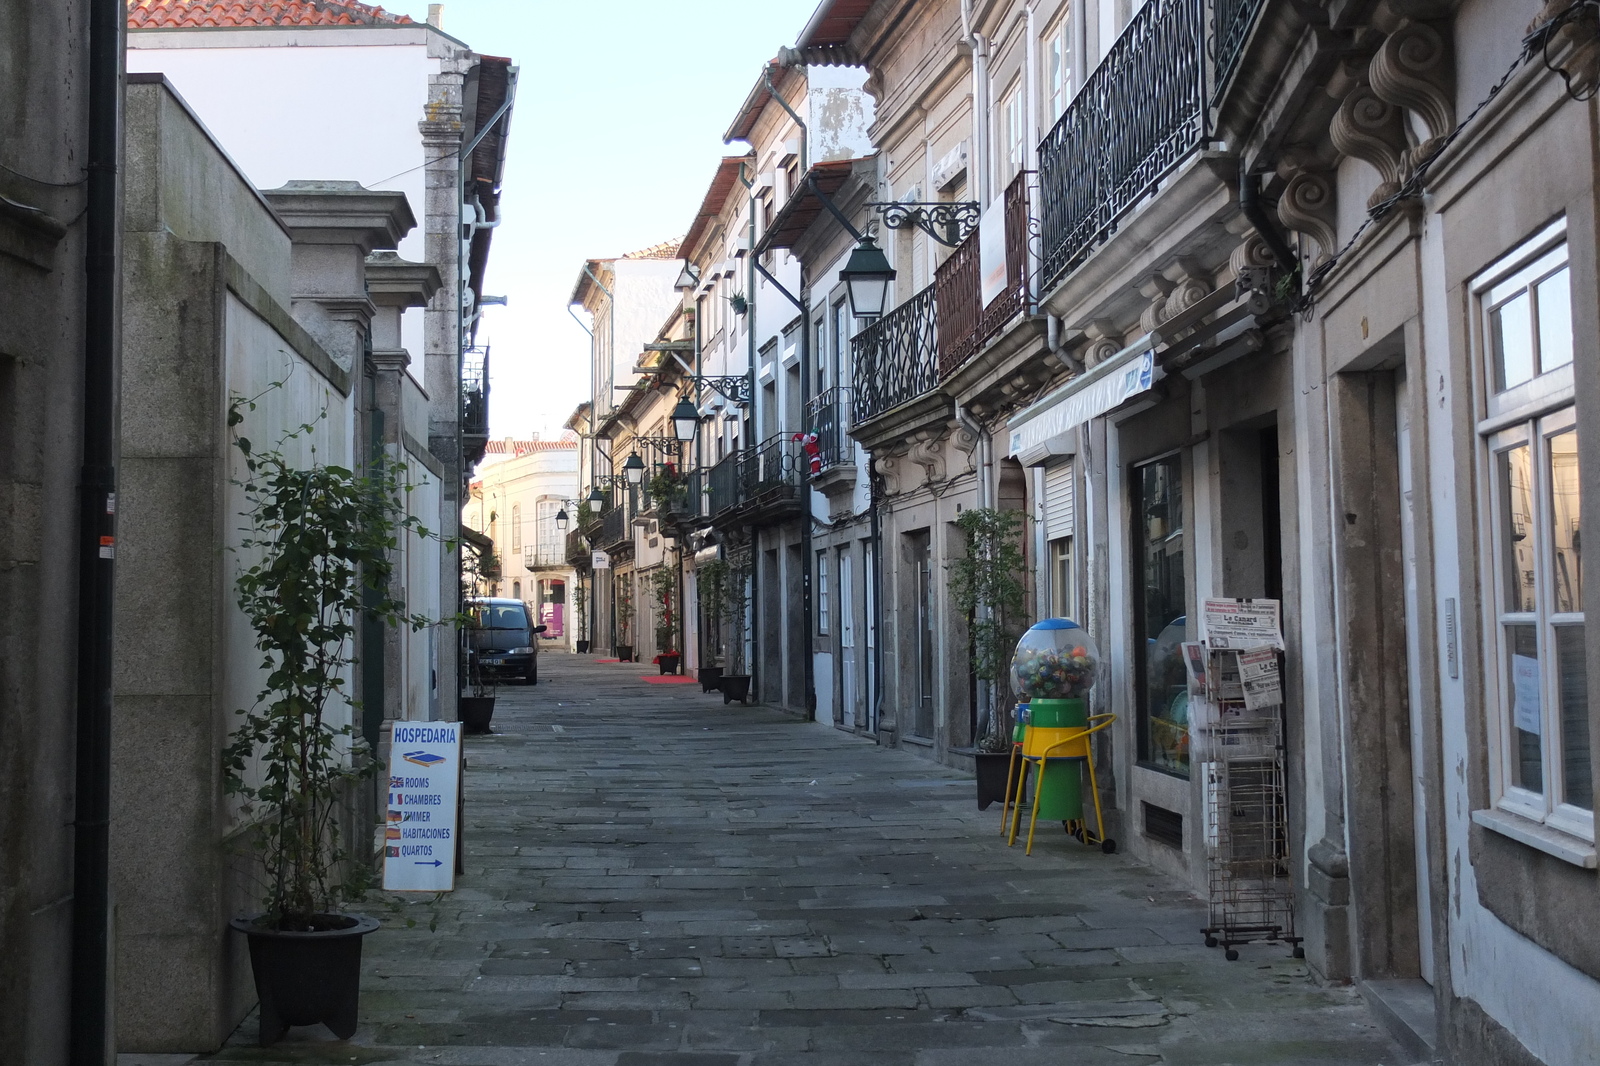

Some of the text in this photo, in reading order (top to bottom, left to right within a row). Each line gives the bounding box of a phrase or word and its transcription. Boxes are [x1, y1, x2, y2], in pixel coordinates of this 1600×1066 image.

[394, 727, 456, 744] HOSPEDARIA
[405, 777, 430, 788] ROOMS
[404, 794, 442, 806] CHAMBRES
[402, 828, 451, 839] HABITACIONES
[401, 845, 433, 857] QUARTOS
